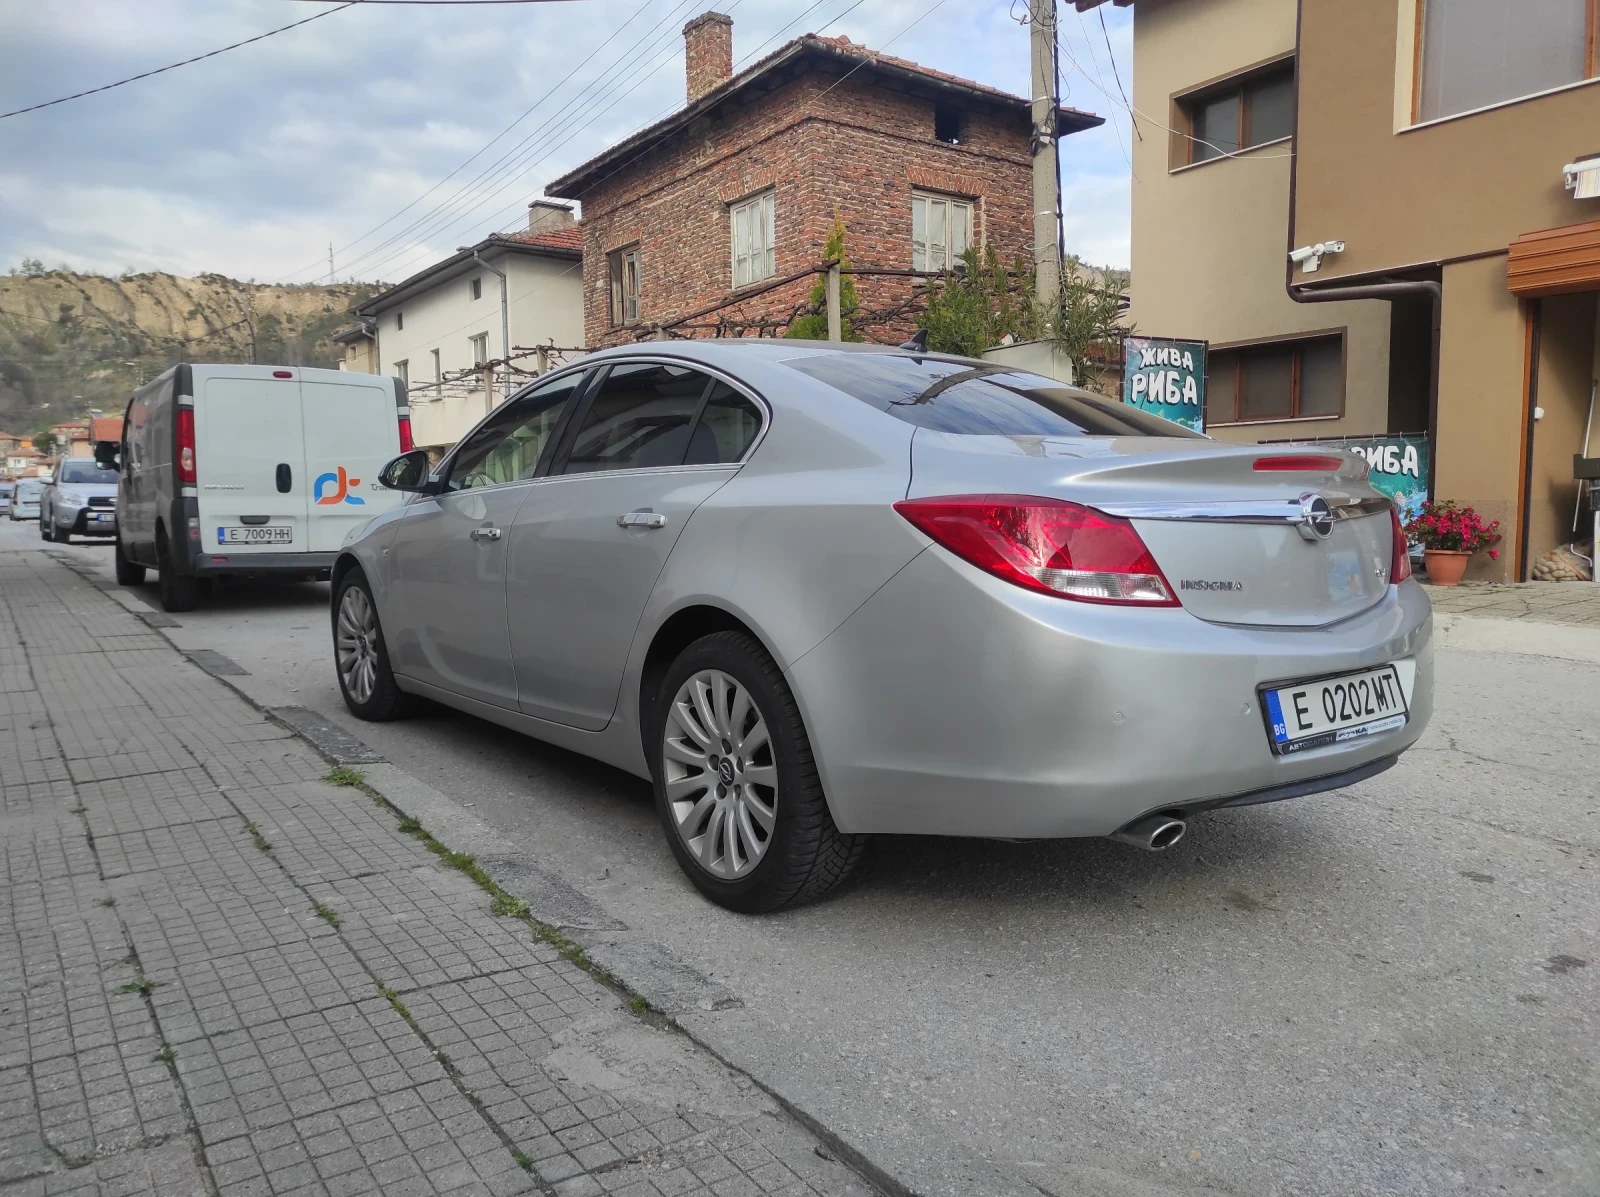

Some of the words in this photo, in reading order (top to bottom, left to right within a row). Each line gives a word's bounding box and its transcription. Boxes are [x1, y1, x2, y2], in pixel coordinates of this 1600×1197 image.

[1140, 347, 1193, 372] ЖИВА
[1131, 370, 1198, 405] РИБА
[230, 529, 239, 540] E
[1181, 580, 1243, 591] INSIGNIA
[1292, 691, 1313, 730] E
[1273, 724, 1286, 736] BG
